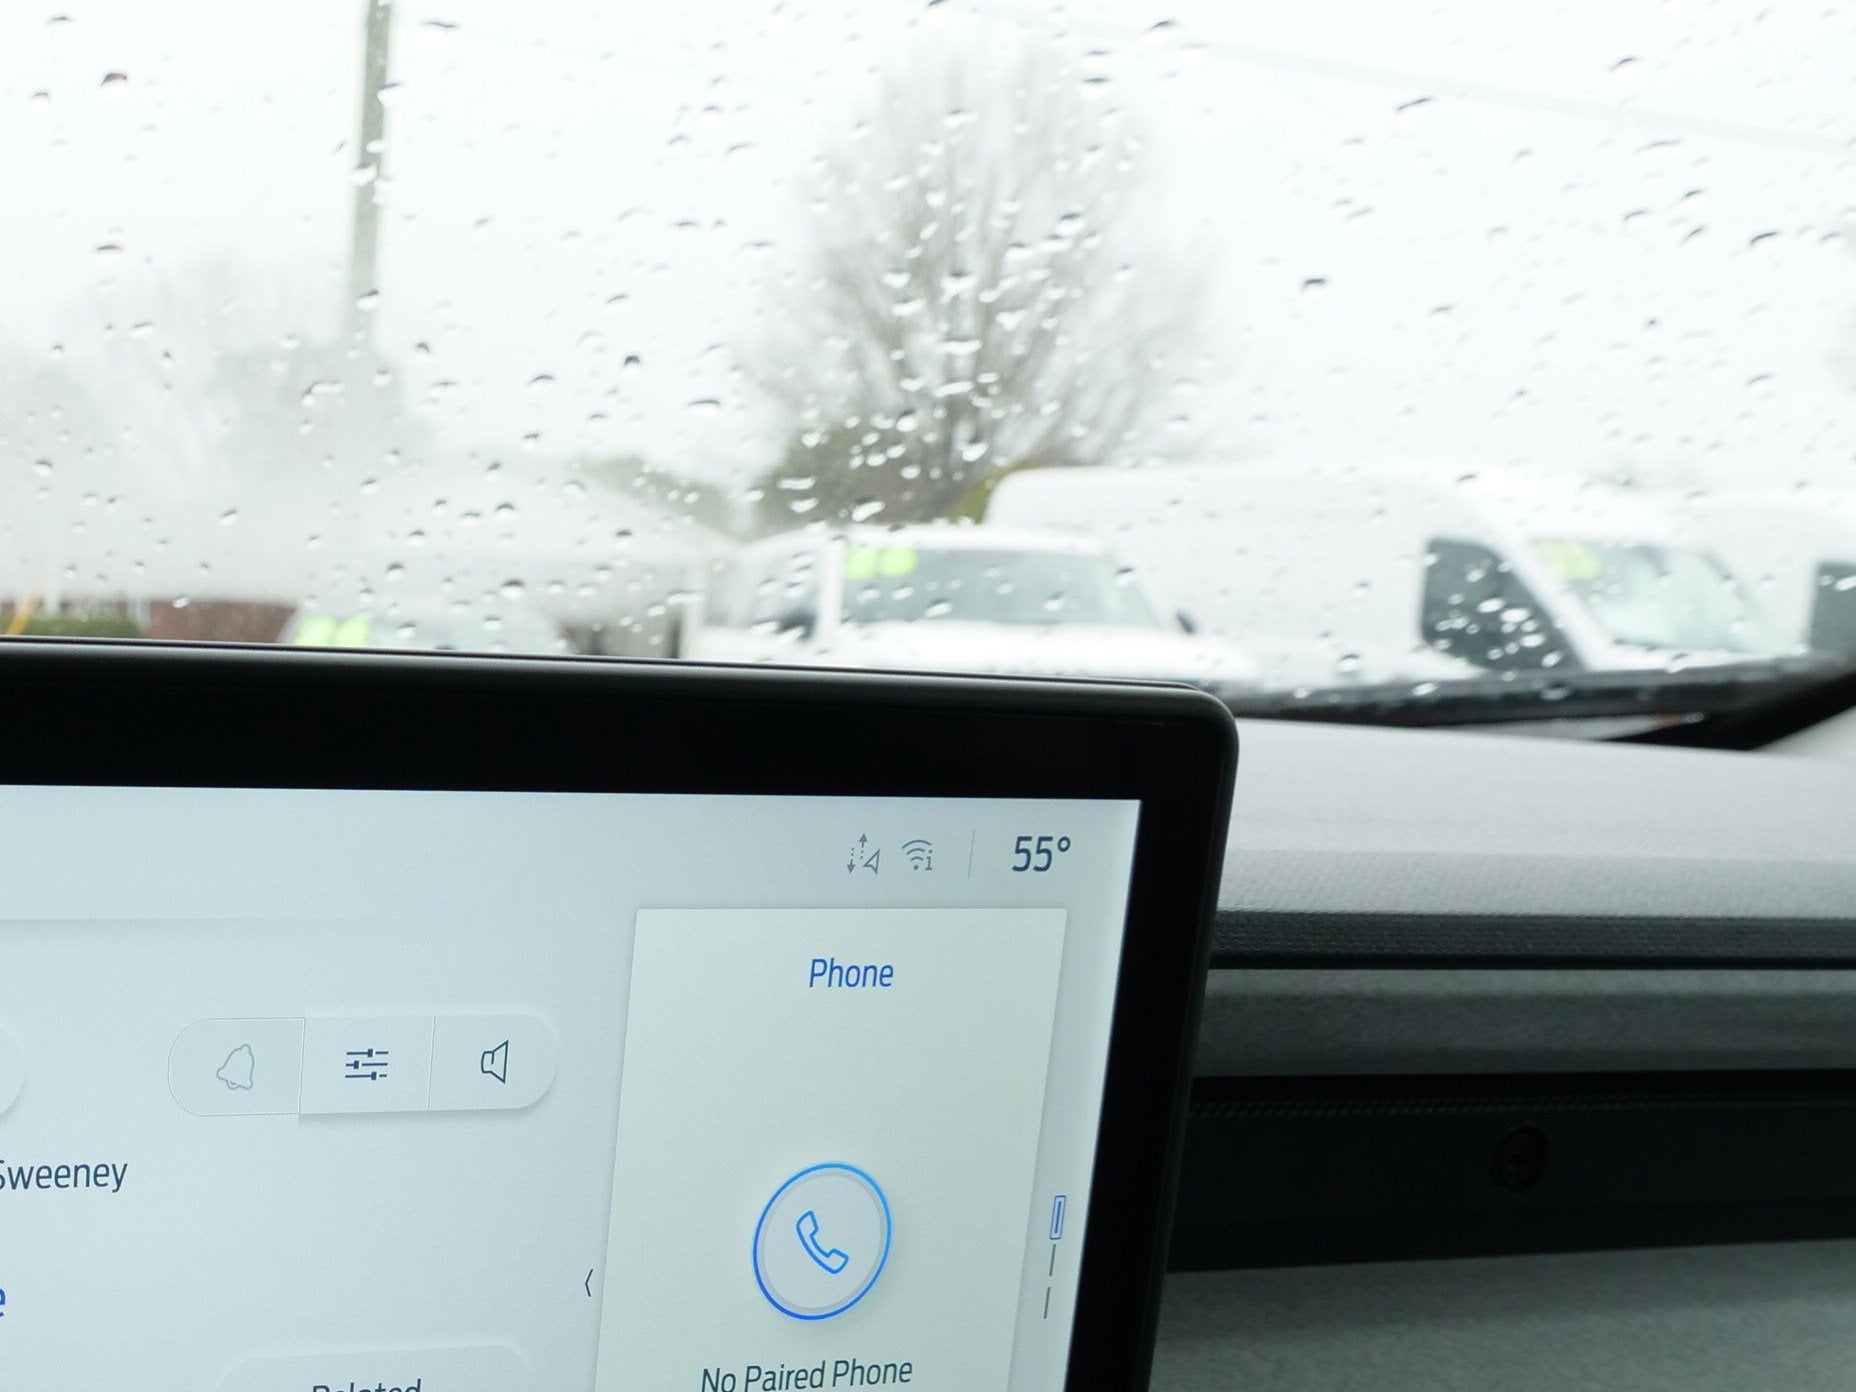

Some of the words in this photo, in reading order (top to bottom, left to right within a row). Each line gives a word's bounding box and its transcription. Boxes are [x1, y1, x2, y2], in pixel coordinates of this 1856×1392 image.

[809, 957, 894, 989] Phone
[744, 1363, 825, 1392] Paired
[832, 1359, 913, 1386] Phone
